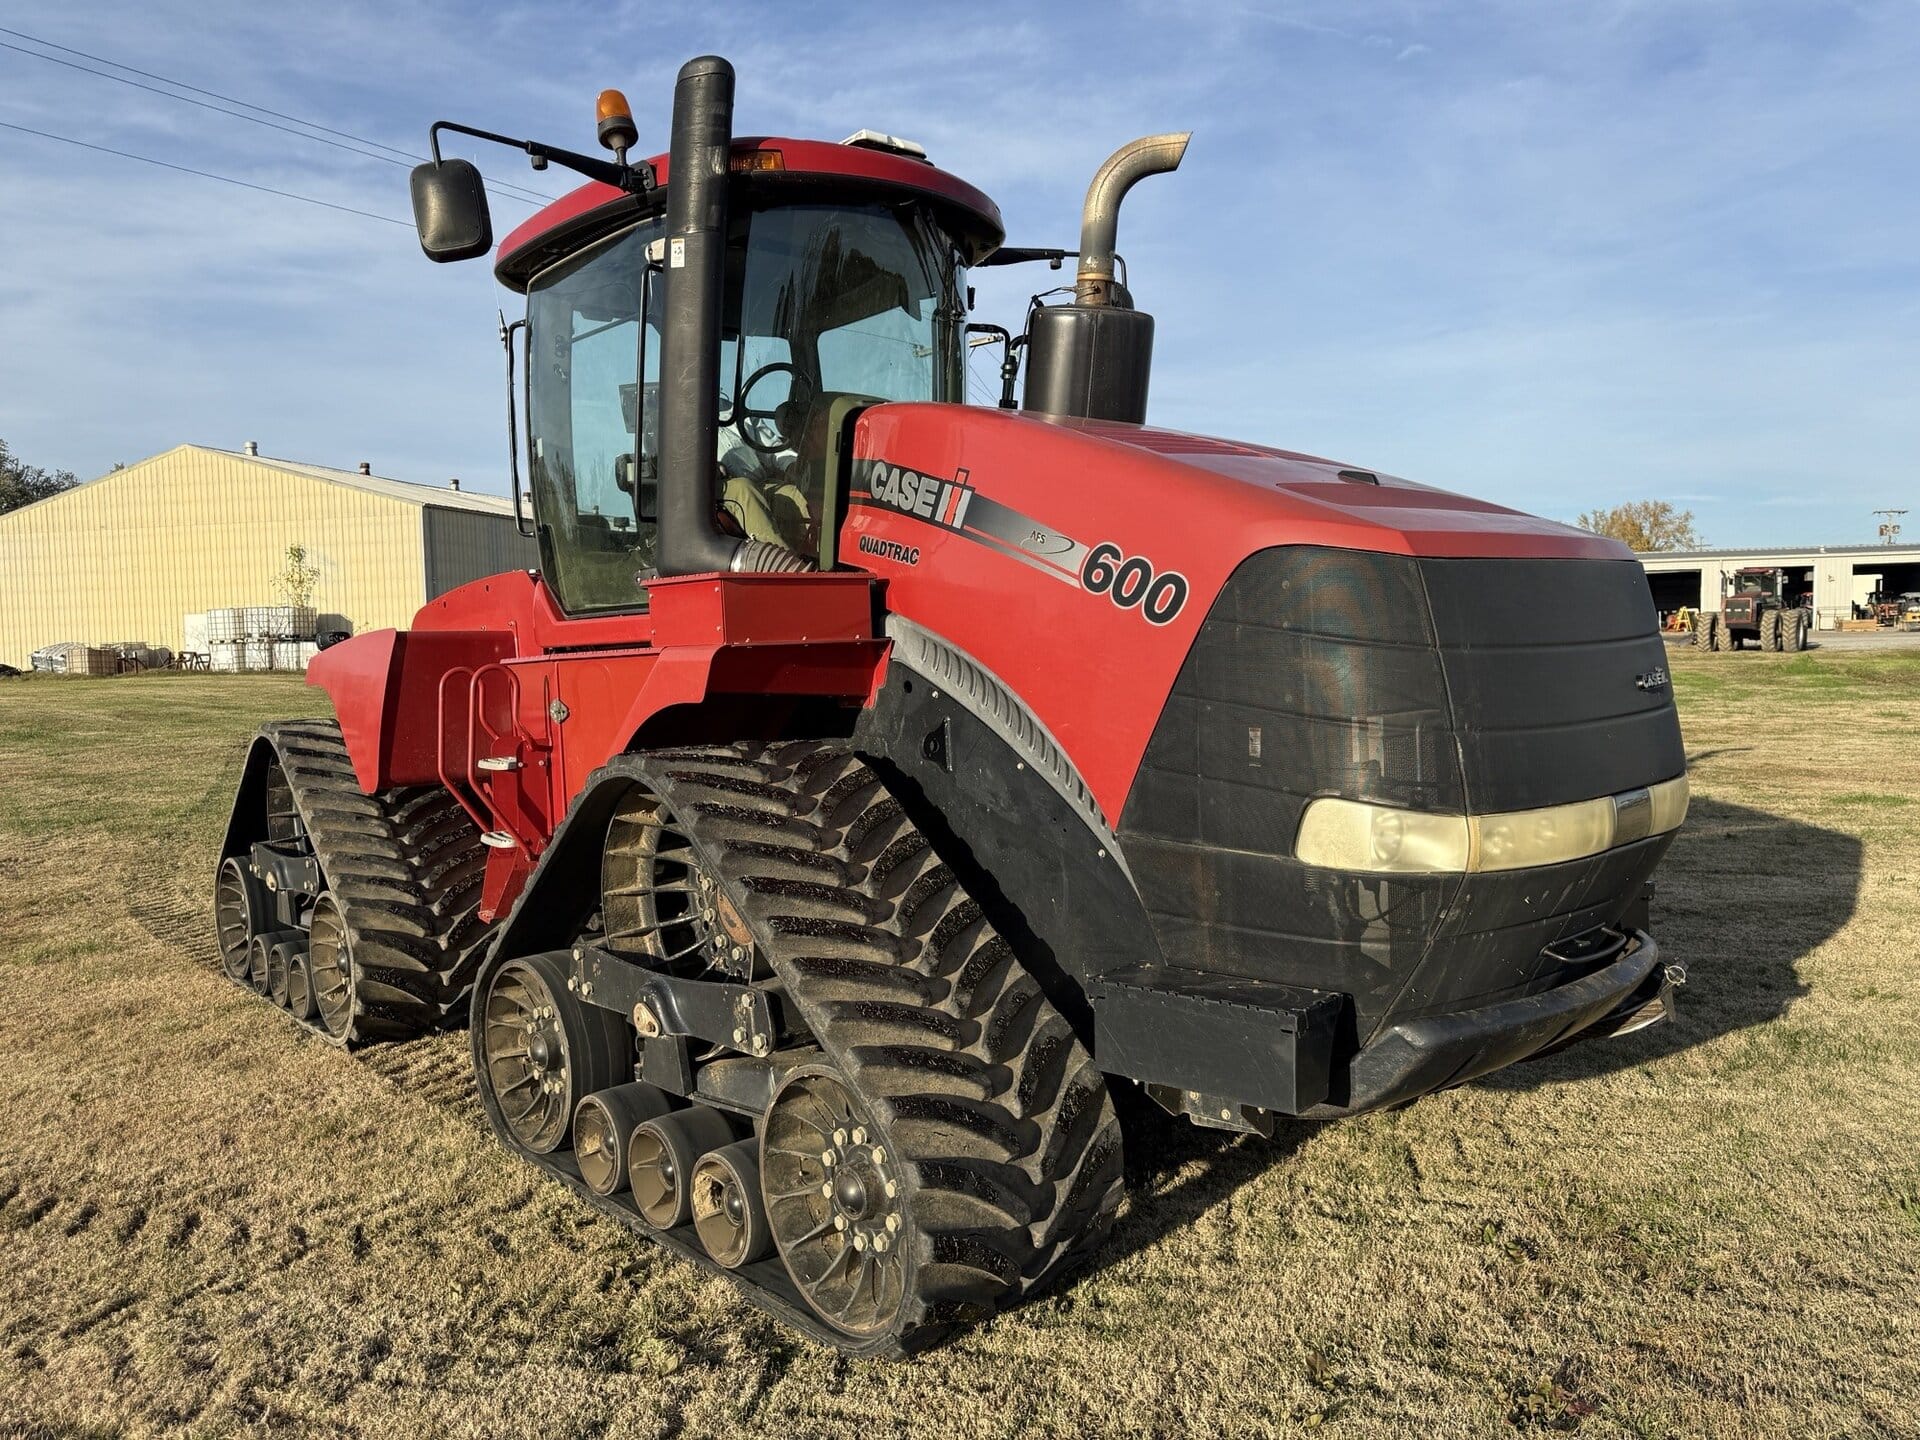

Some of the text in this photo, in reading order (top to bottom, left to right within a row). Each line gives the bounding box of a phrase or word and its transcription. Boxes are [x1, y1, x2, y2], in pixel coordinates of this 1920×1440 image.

[870, 461, 940, 518] CASE
[858, 535, 920, 566] QUADTRAC
[1030, 530, 1046, 544] AFS
[1081, 542, 1189, 627] 600
